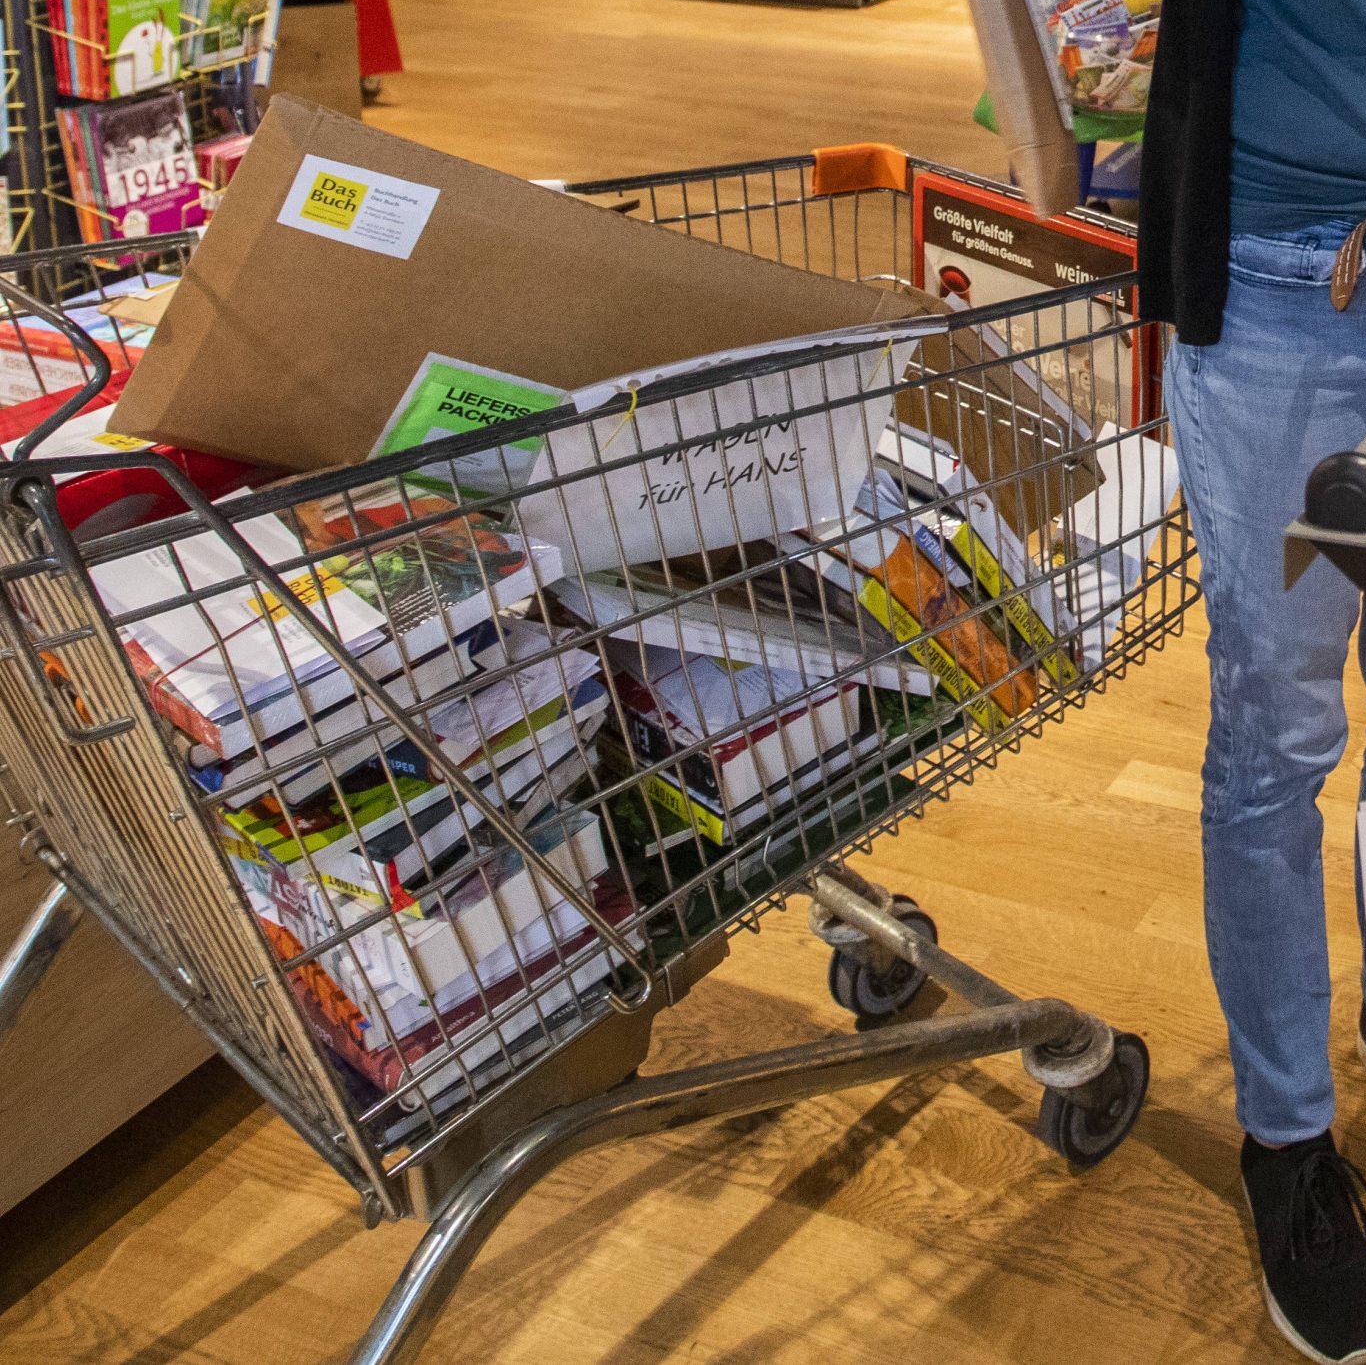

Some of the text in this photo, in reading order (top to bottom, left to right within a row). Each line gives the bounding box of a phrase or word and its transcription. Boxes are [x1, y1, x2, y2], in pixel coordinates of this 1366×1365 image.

[118, 156, 190, 204] 1945
[321, 177, 359, 199] Das
[309, 189, 358, 213] Buch
[933, 205, 1014, 245] Größte Vielfalt
[951, 230, 1035, 269] für größten Genuss.
[437, 402, 508, 426] PACKI
[445, 387, 533, 418] LIEFERS
[638, 447, 808, 510] für HANS
